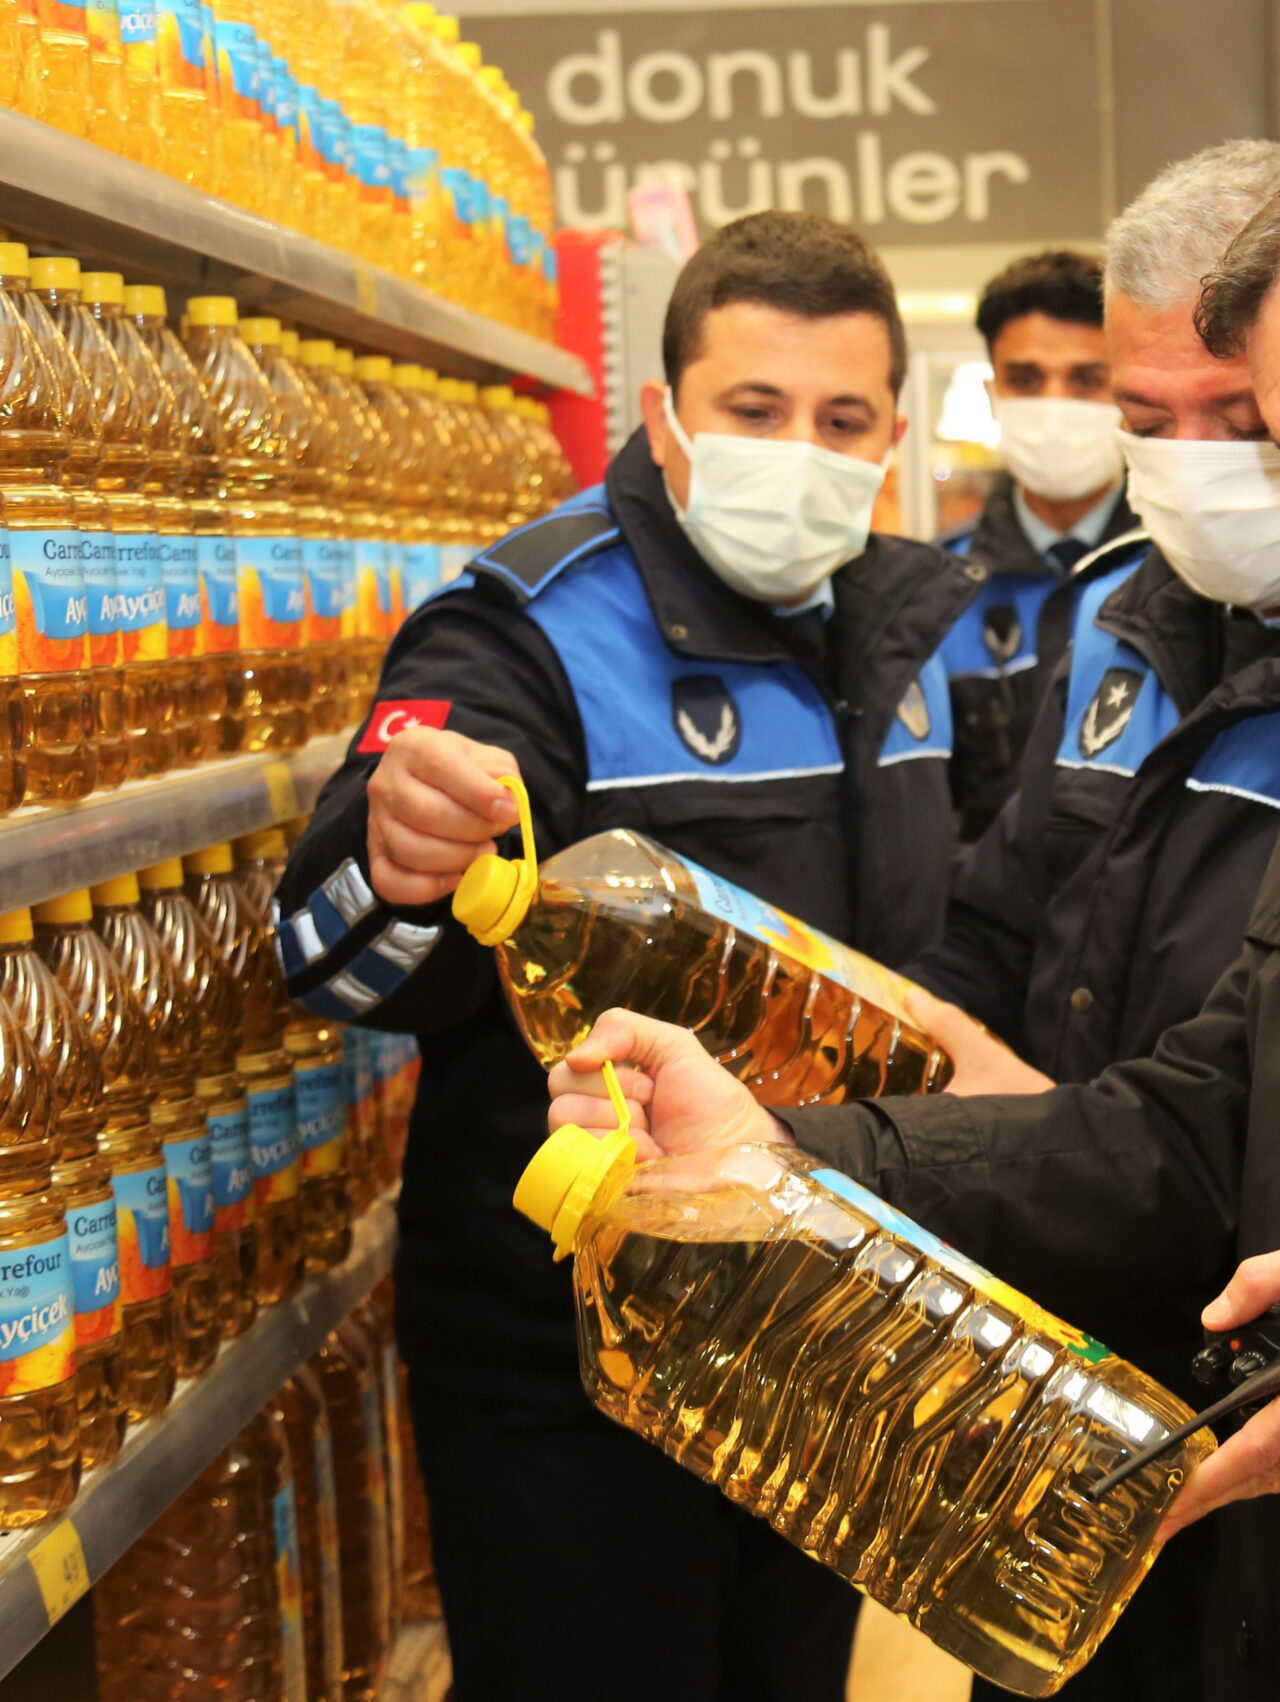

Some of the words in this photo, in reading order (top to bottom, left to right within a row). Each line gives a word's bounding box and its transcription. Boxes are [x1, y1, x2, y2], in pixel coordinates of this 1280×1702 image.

[546, 22, 936, 126] donuk
[554, 131, 1029, 231] ürünler
[0, 1293, 68, 1349] yçiçek
